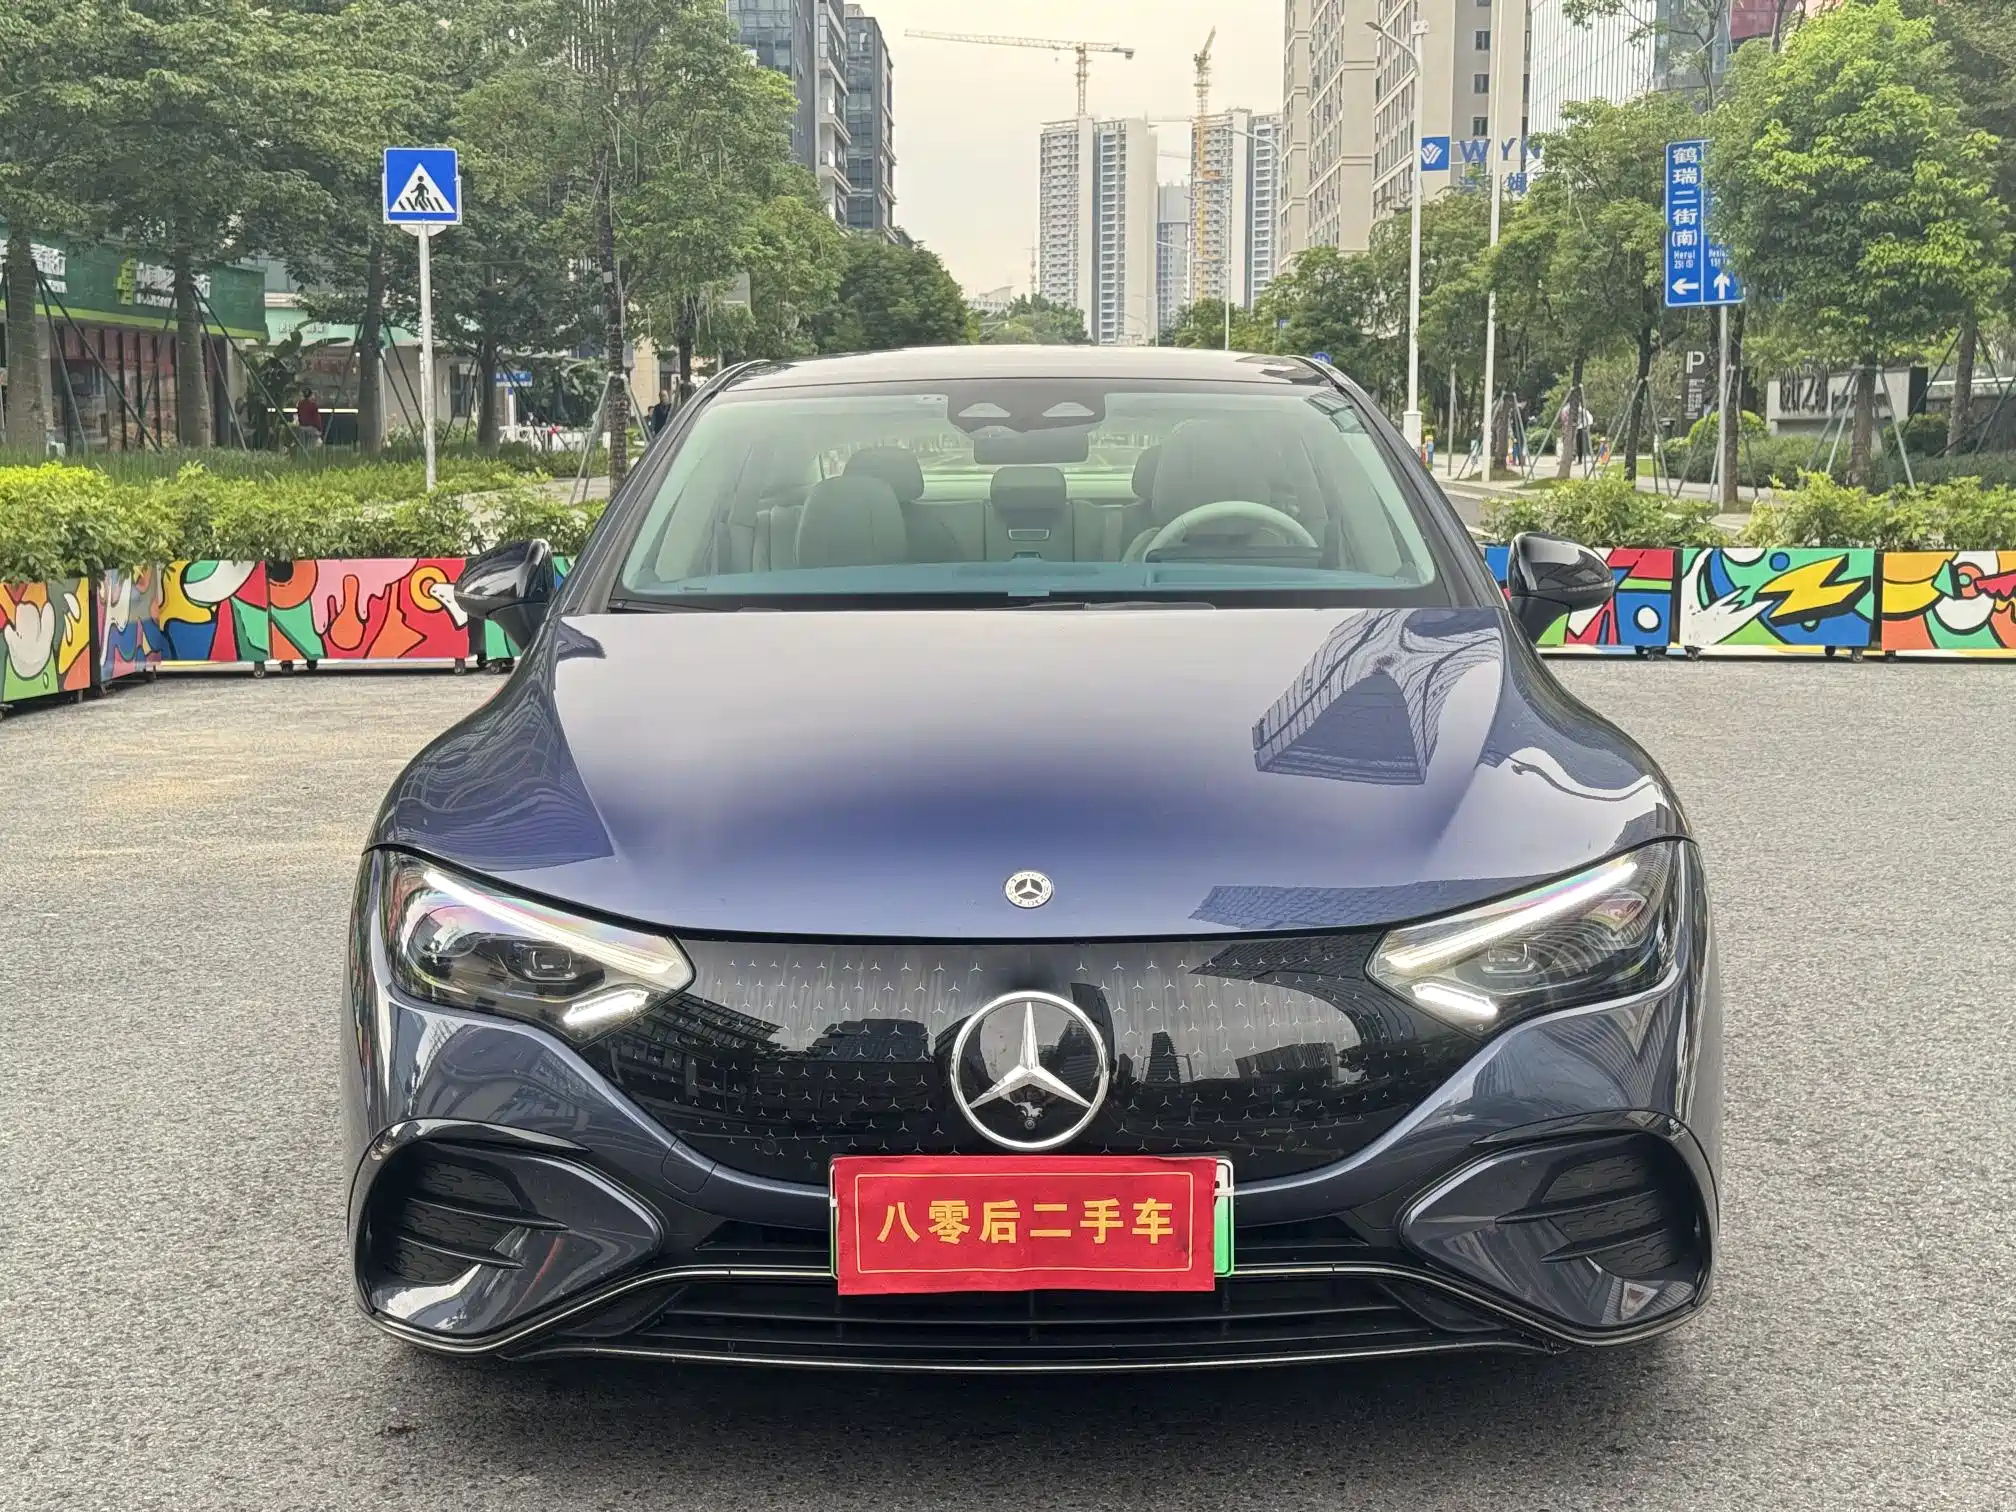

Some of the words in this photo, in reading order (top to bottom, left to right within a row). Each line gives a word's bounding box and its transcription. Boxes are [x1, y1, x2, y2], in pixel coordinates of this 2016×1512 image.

[1686, 350, 1705, 374] P
[876, 1198, 1175, 1245] 八零后二手车
